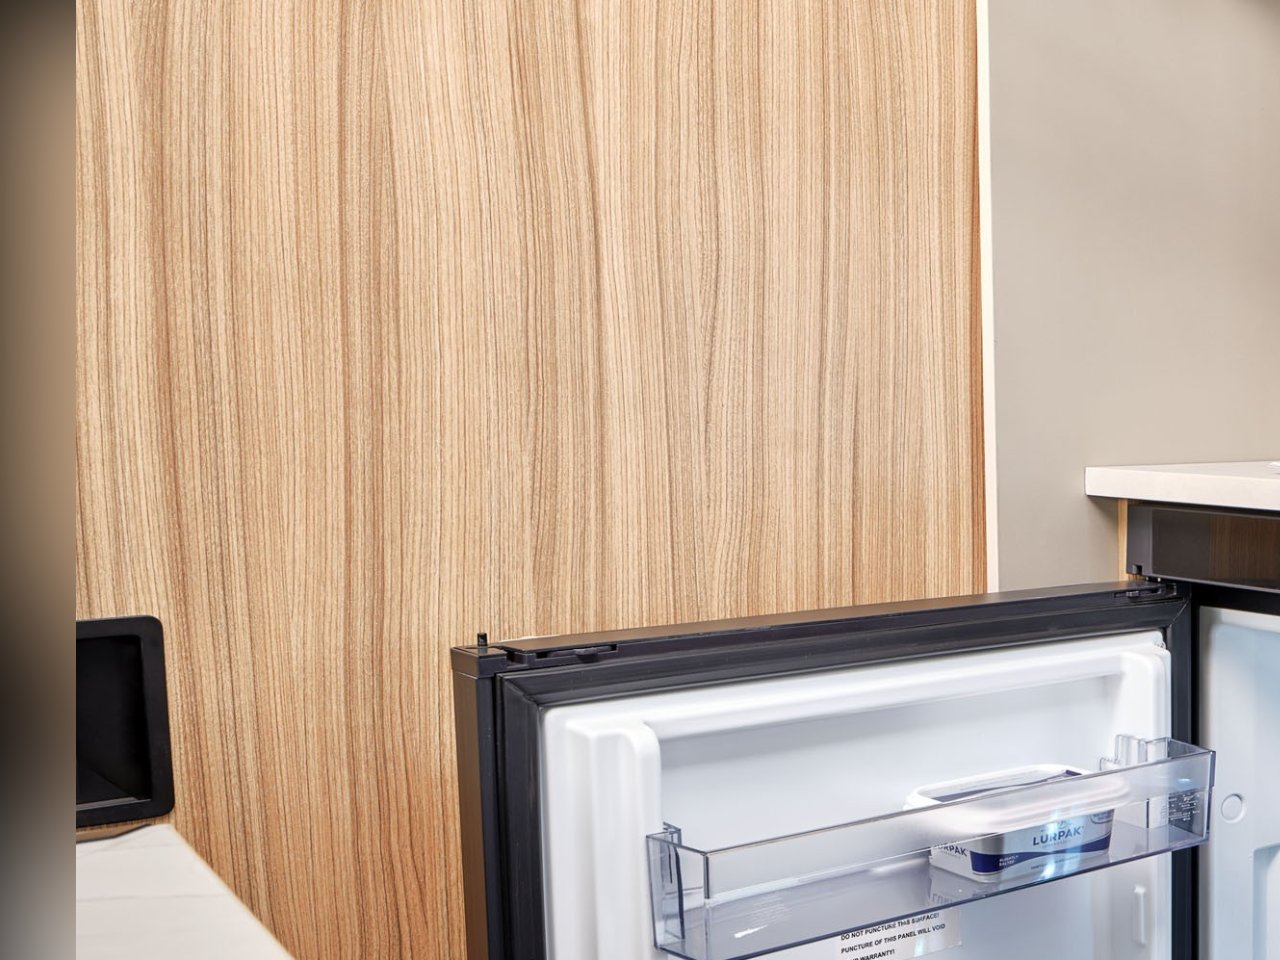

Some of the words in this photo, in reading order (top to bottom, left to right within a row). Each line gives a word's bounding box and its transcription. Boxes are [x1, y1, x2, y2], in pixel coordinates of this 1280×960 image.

[1033, 826, 1082, 846] LURPAK
[841, 941, 873, 954] PUNCTURE
[874, 938, 883, 946] OF
[884, 936, 897, 944] THIS
[898, 931, 917, 940] PANEL
[918, 928, 931, 936] WILL
[932, 923, 946, 932] VOID
[851, 930, 864, 939] NOT
